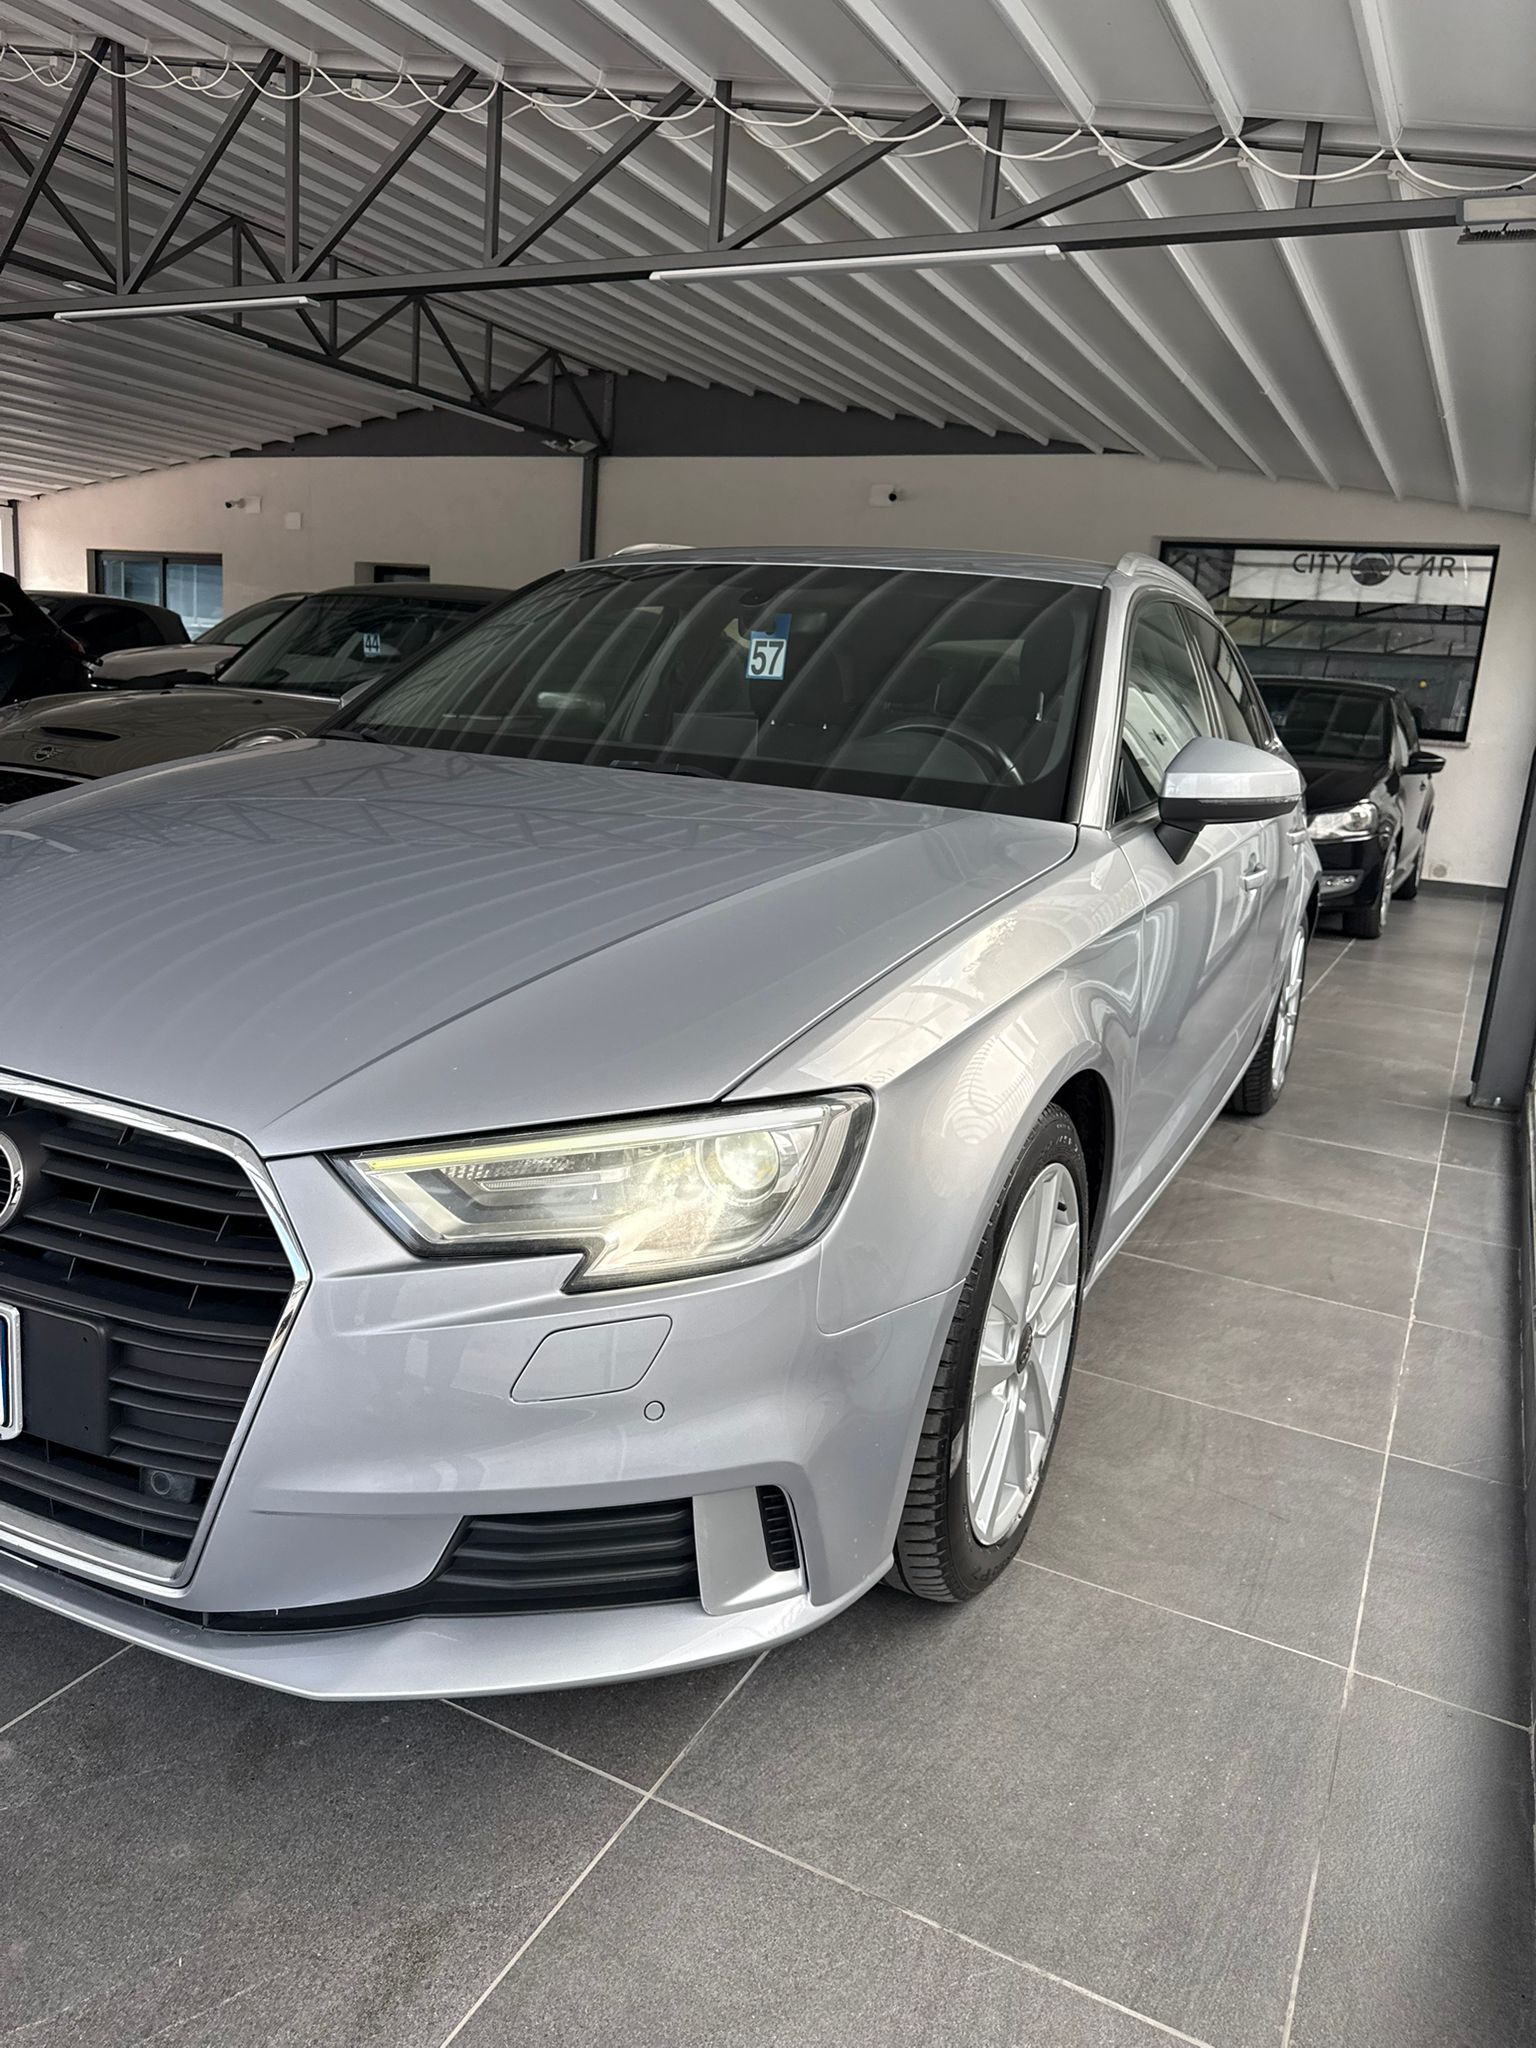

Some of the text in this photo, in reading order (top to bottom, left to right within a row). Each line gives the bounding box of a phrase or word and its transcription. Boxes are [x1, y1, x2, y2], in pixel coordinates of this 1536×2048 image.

[1292, 553, 1456, 578] CITY CAR
[365, 633, 379, 652] 44
[750, 640, 785, 676] 57
